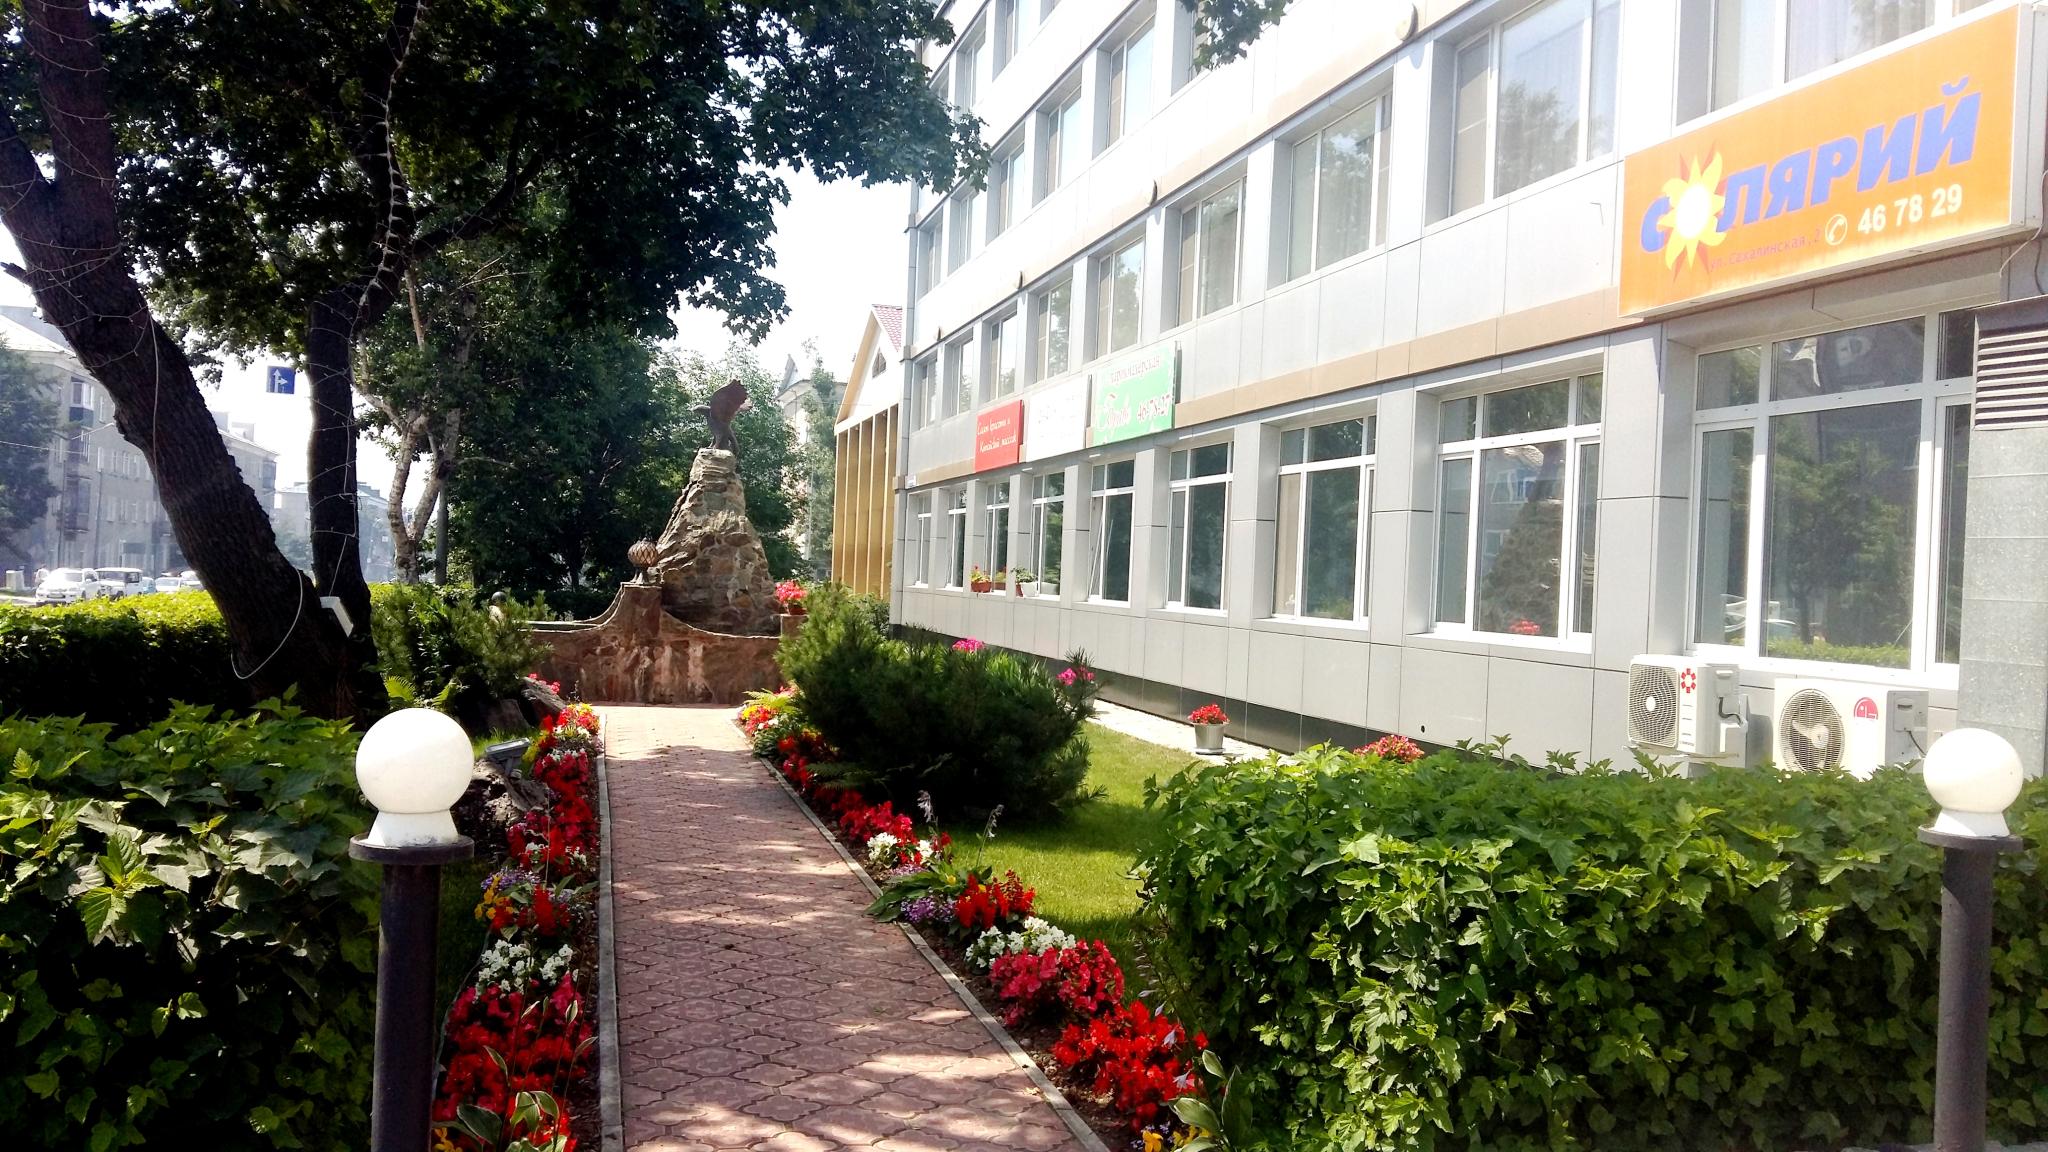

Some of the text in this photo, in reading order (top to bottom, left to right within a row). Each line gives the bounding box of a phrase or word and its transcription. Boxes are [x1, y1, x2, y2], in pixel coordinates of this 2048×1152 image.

[1857, 183, 1963, 235] 46 78 29
